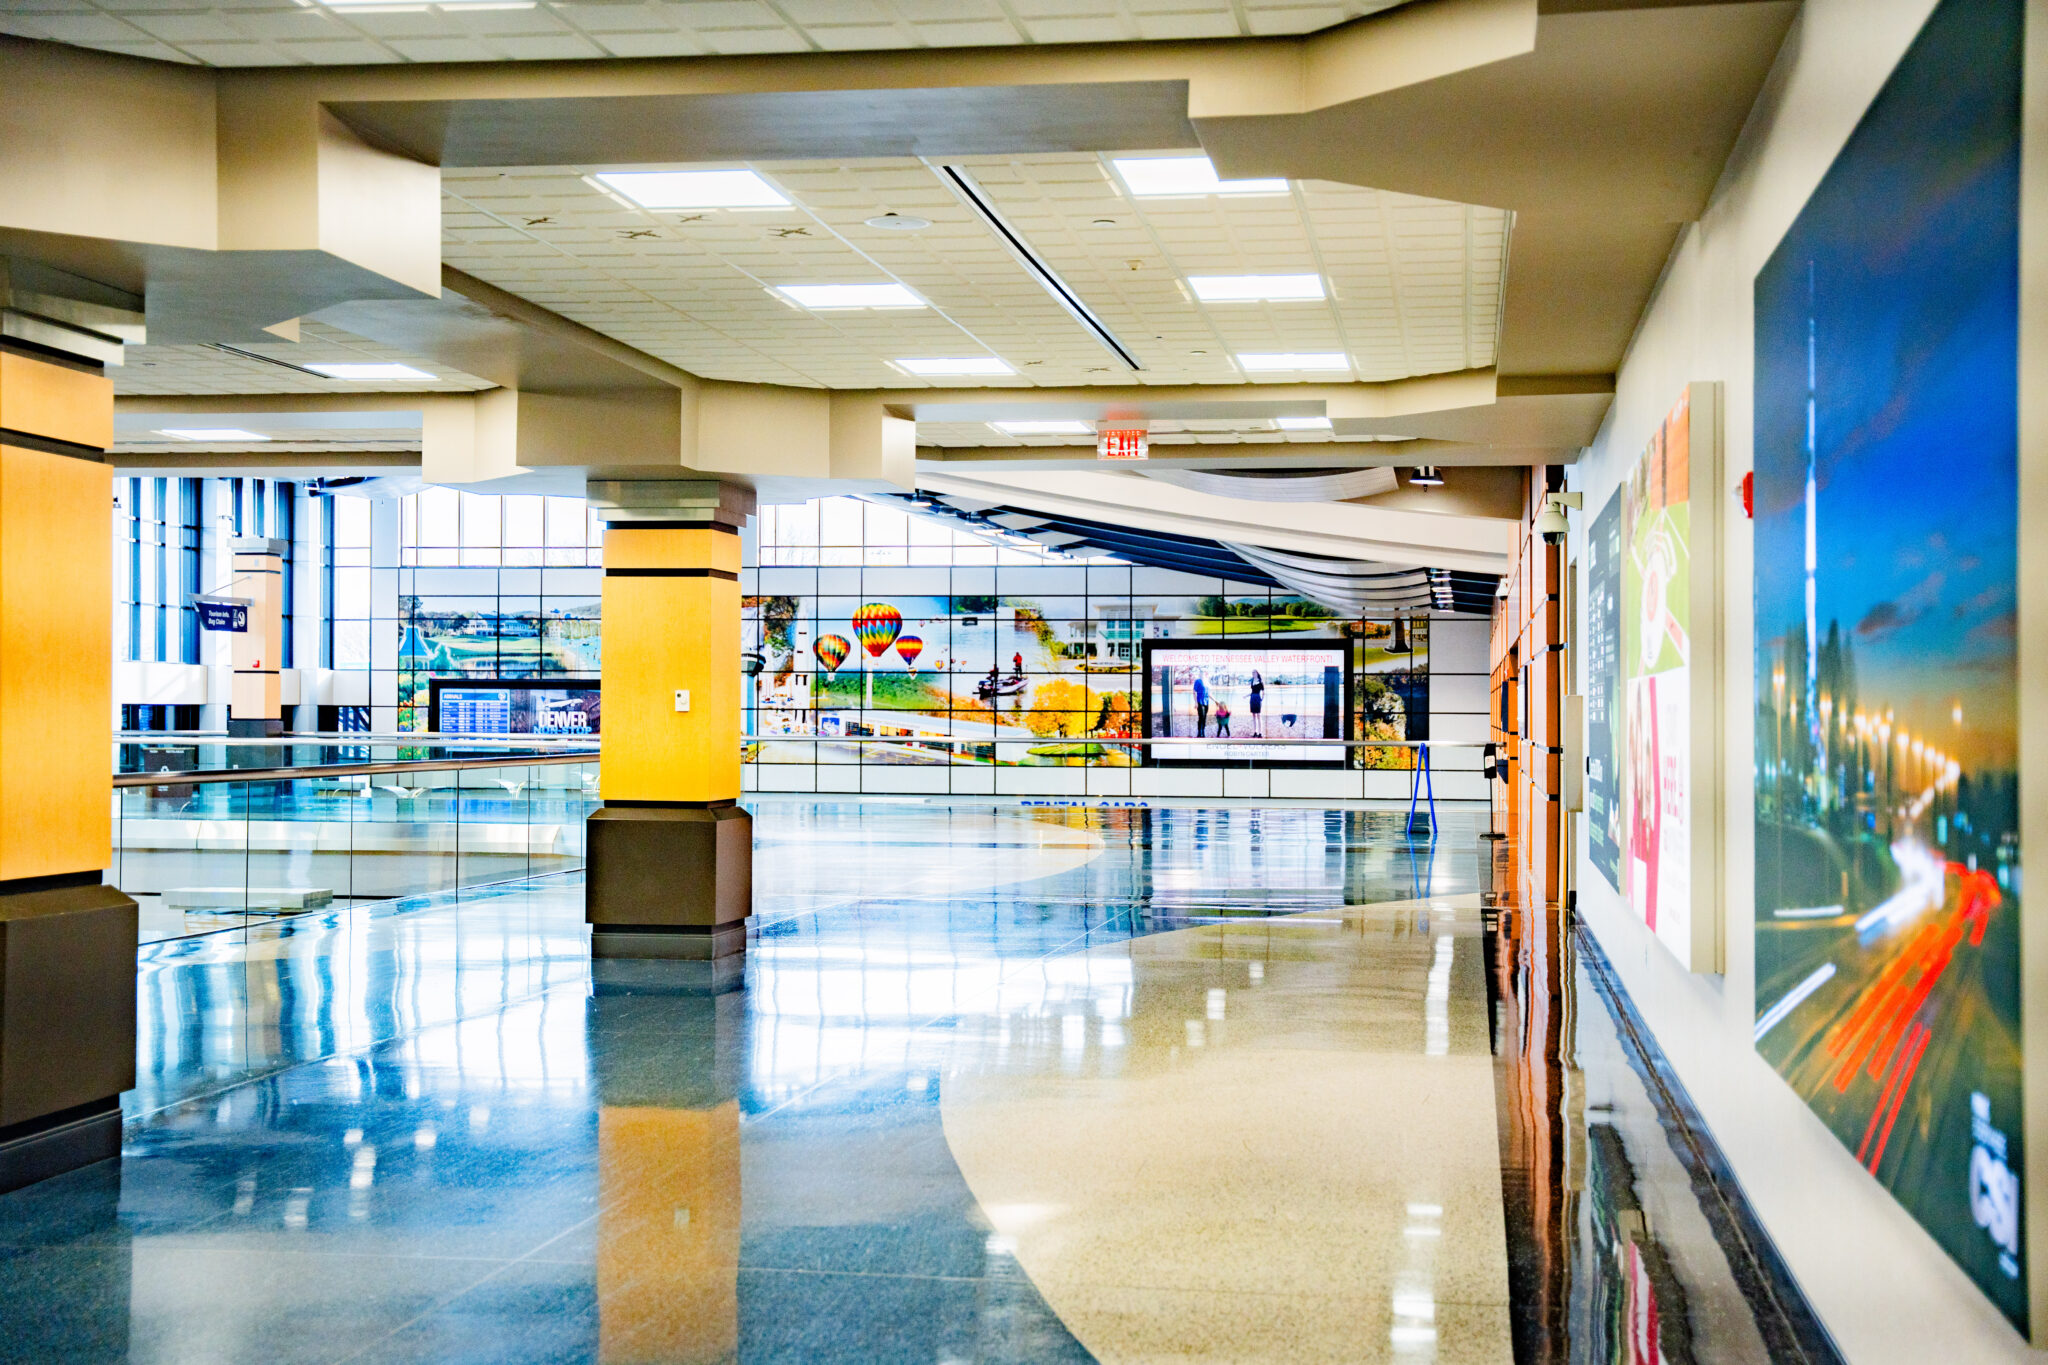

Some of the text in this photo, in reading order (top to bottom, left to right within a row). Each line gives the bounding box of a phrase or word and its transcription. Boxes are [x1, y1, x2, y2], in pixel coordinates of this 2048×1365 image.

[1107, 434, 1138, 456] EXIT
[1162, 654, 1199, 663] WELCOME
[1200, 654, 1210, 663] TO
[1211, 654, 1252, 663] TENNESSEE
[1253, 654, 1280, 663] VALLEY
[538, 710, 587, 728] DENVER
[533, 725, 592, 734] NON-STOP
